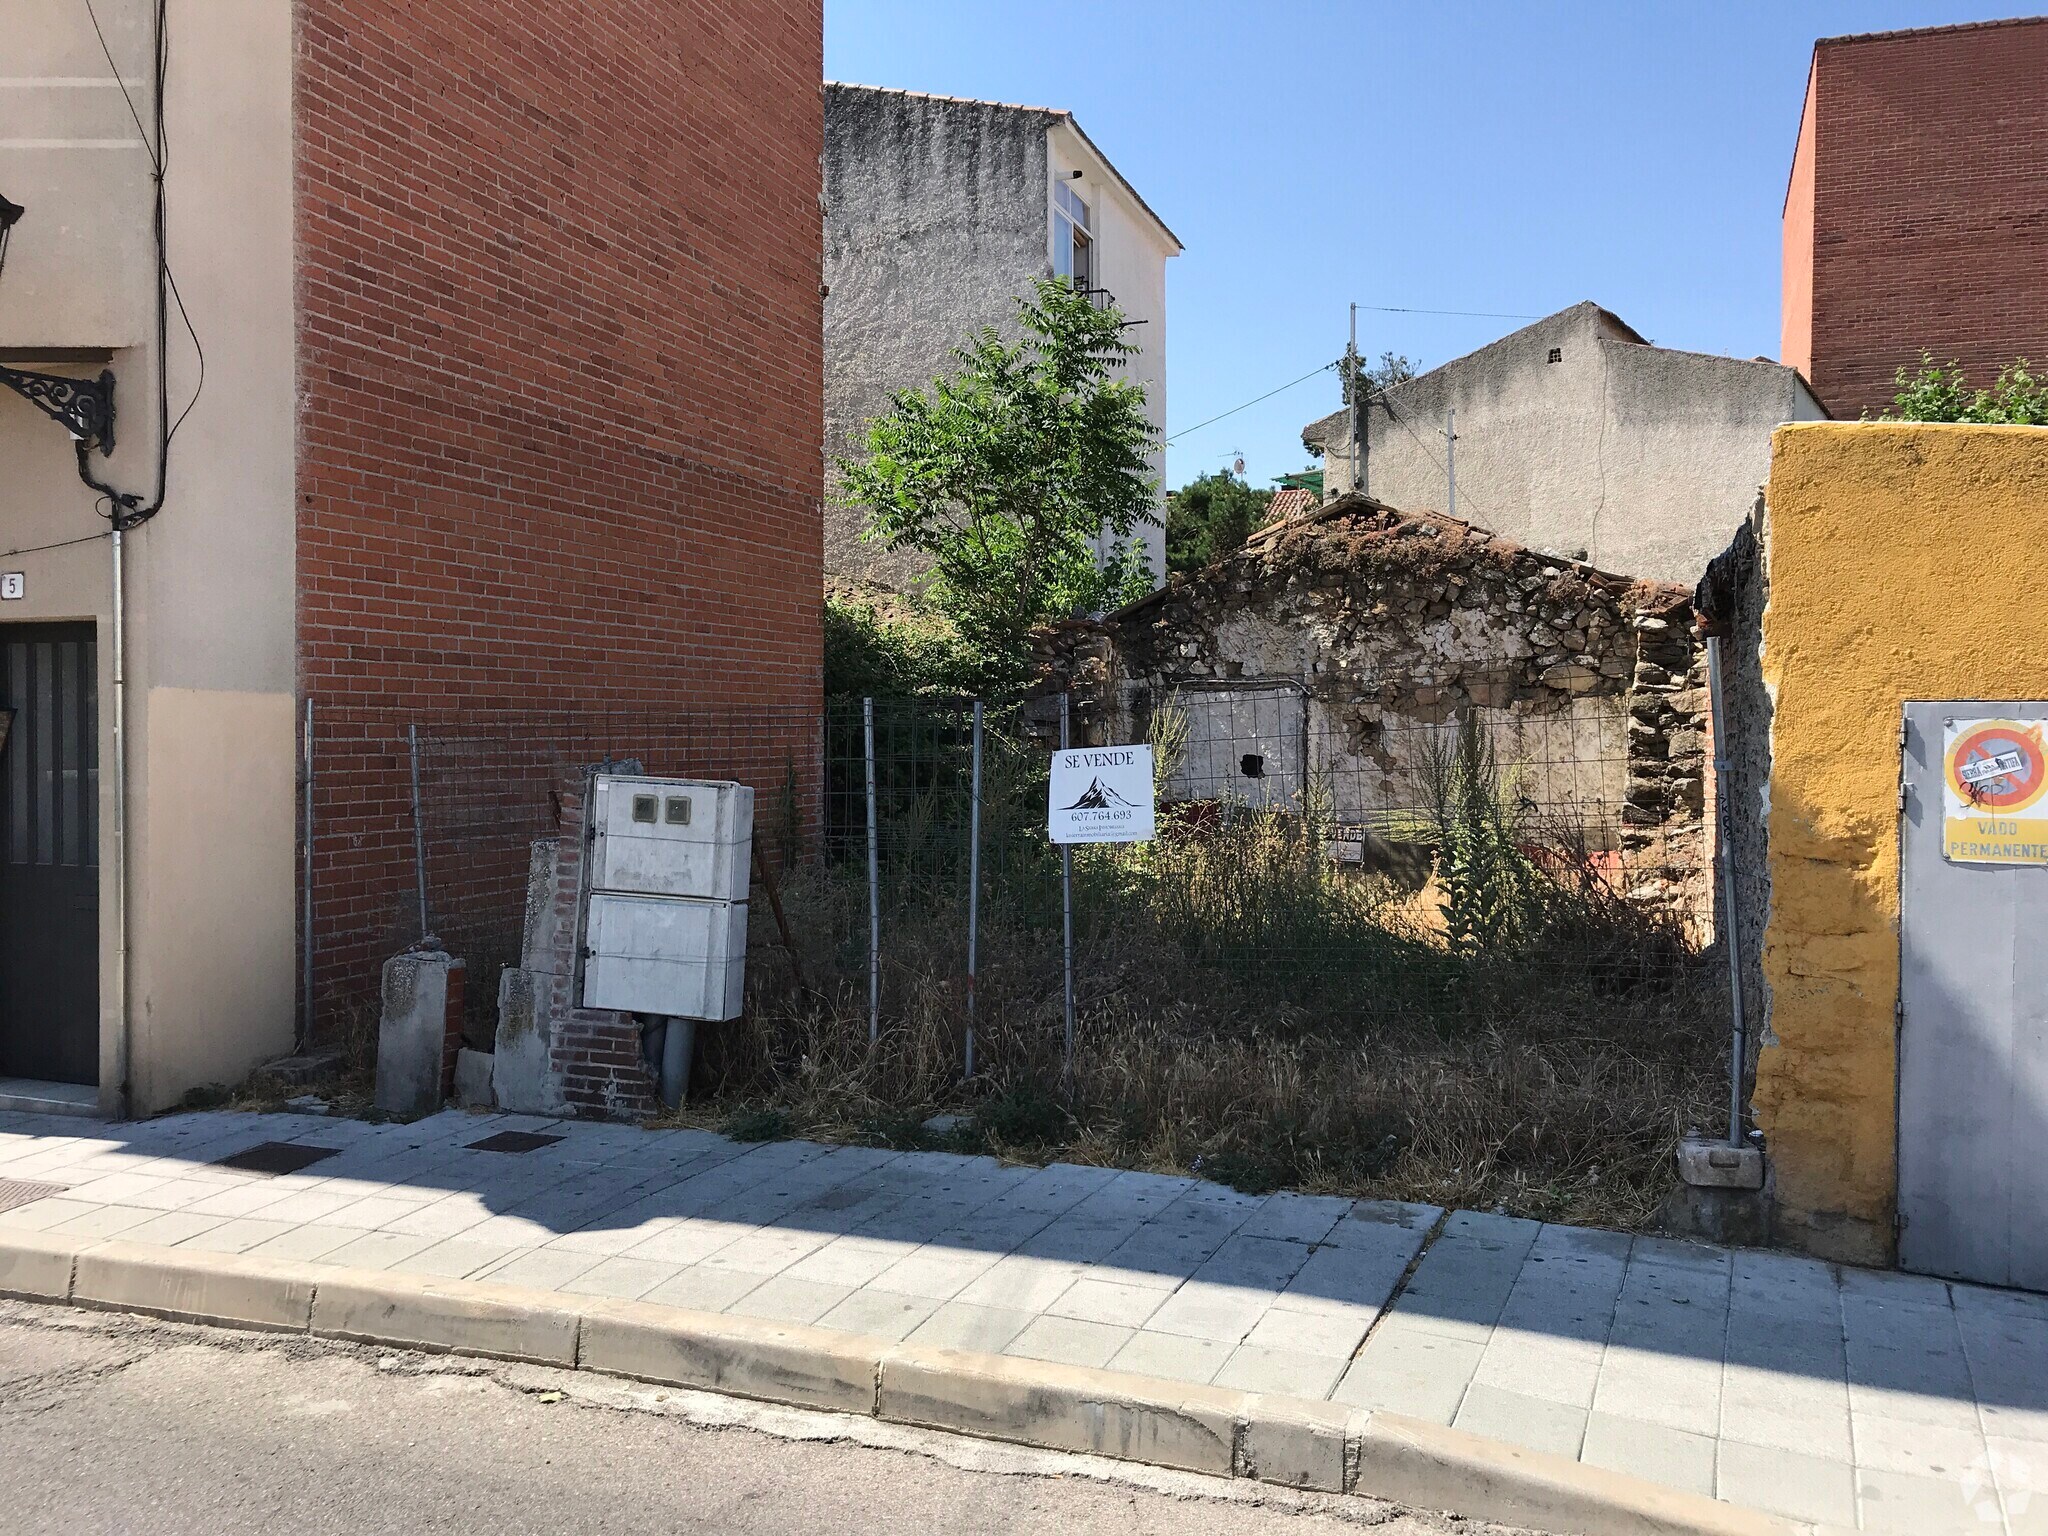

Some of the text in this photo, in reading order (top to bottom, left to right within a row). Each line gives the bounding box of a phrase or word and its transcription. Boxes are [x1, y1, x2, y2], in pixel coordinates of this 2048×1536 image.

[9, 577, 16, 594] 5
[1065, 752, 1134, 769] SE VENDE
[1071, 810, 1132, 821] 607.764.693
[1977, 821, 2018, 836] VADO
[1951, 842, 2048, 858] PERMANENTE
